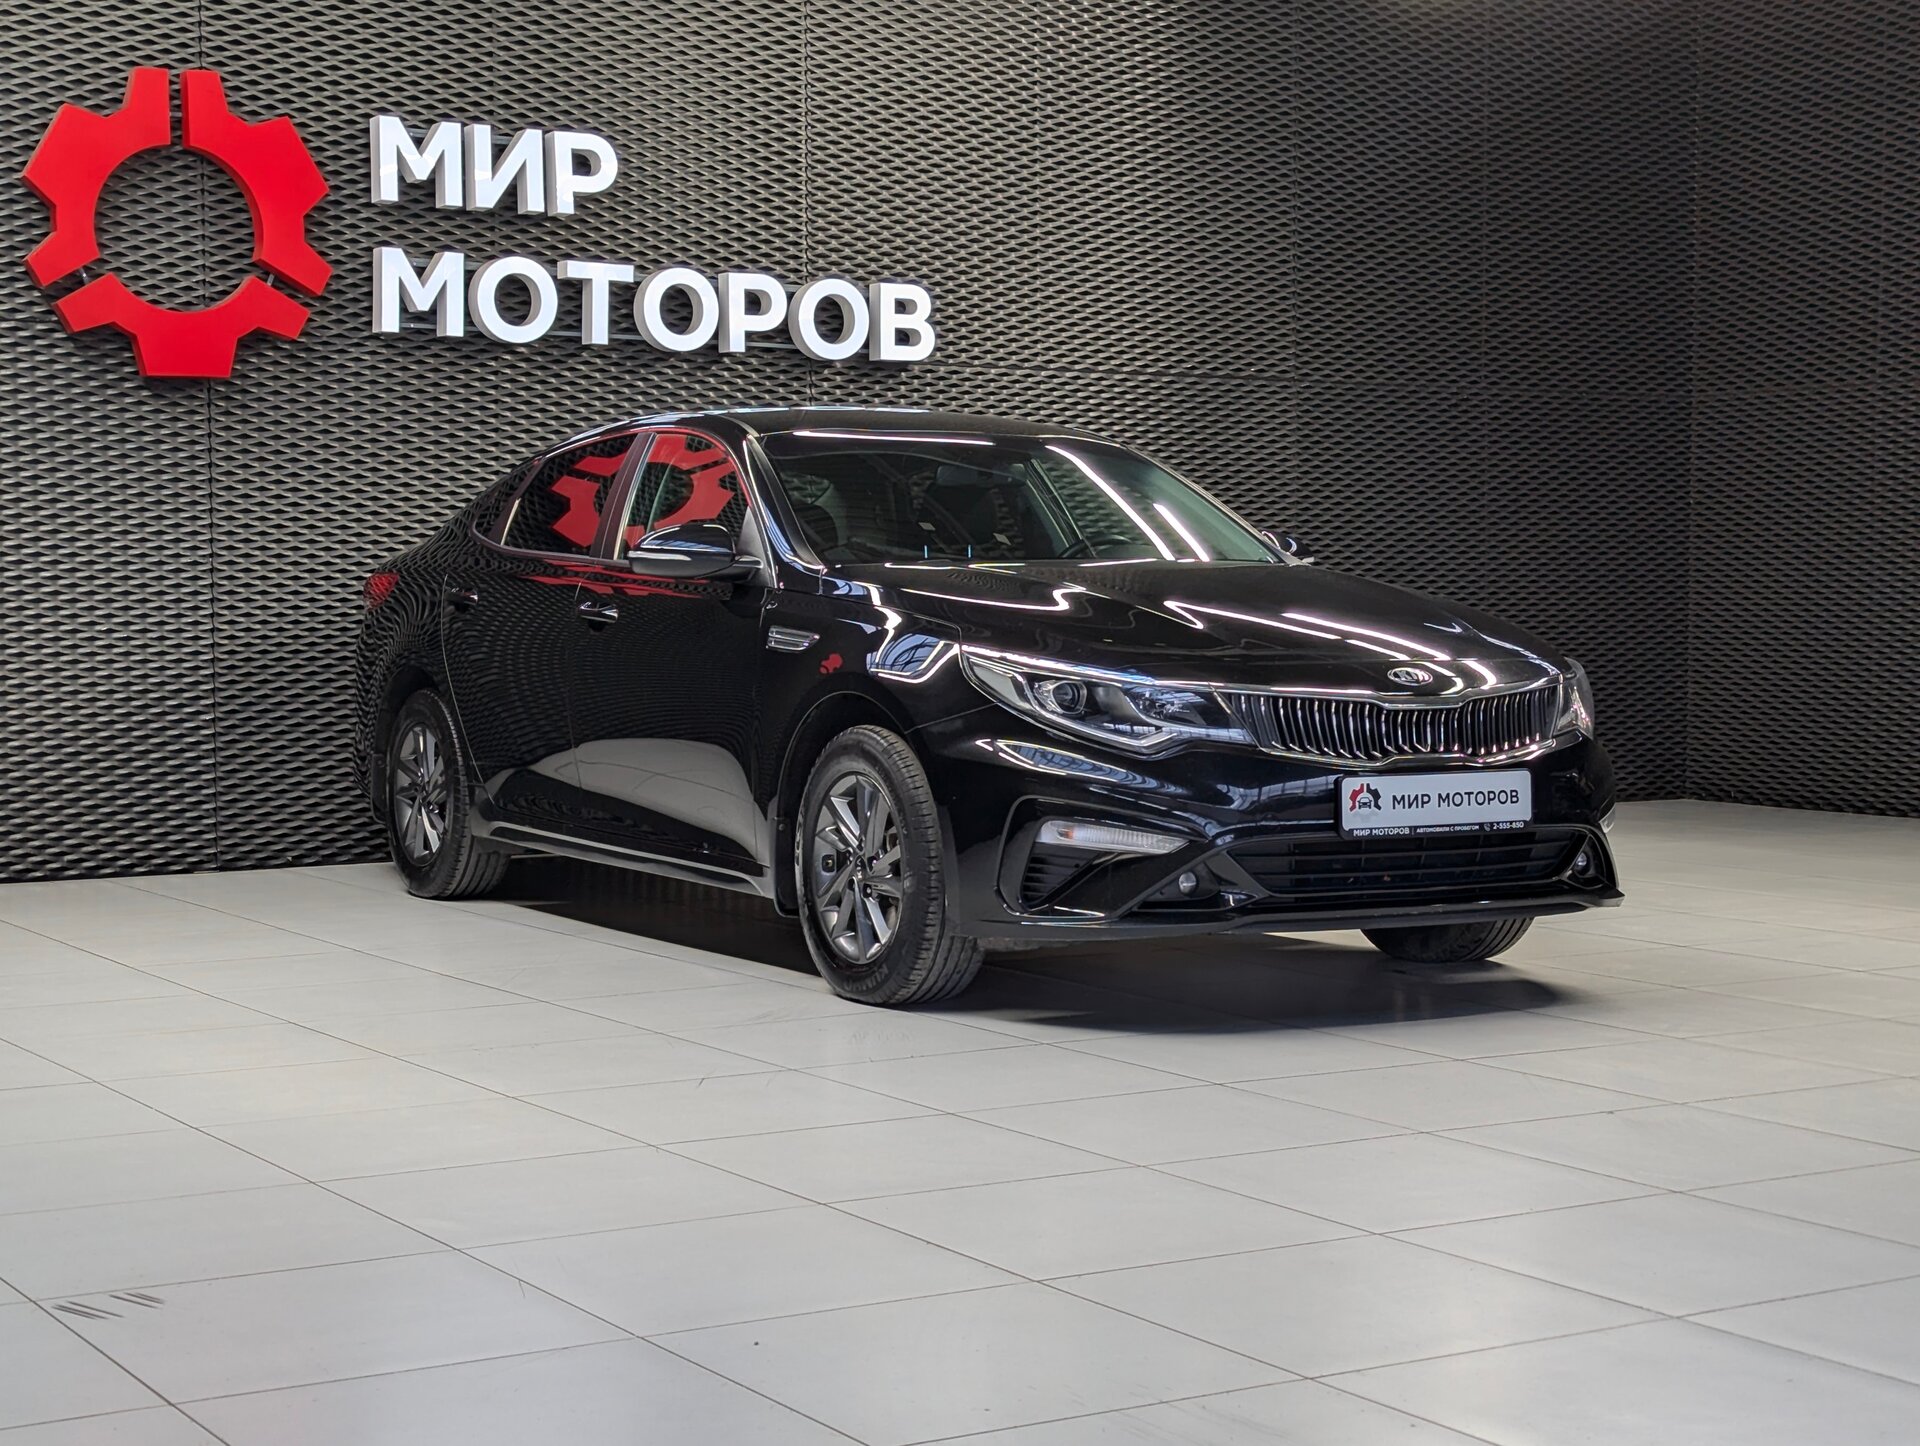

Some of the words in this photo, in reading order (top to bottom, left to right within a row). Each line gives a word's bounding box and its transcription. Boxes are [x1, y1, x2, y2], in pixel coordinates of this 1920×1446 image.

[370, 115, 619, 217] МИР
[372, 246, 936, 362] МОТОРОВ
[1392, 793, 1432, 810] МИР
[1437, 789, 1520, 808] МОТОРОВ
[1353, 828, 1371, 837] МИР
[1372, 827, 1410, 836] МОТОРОВ
